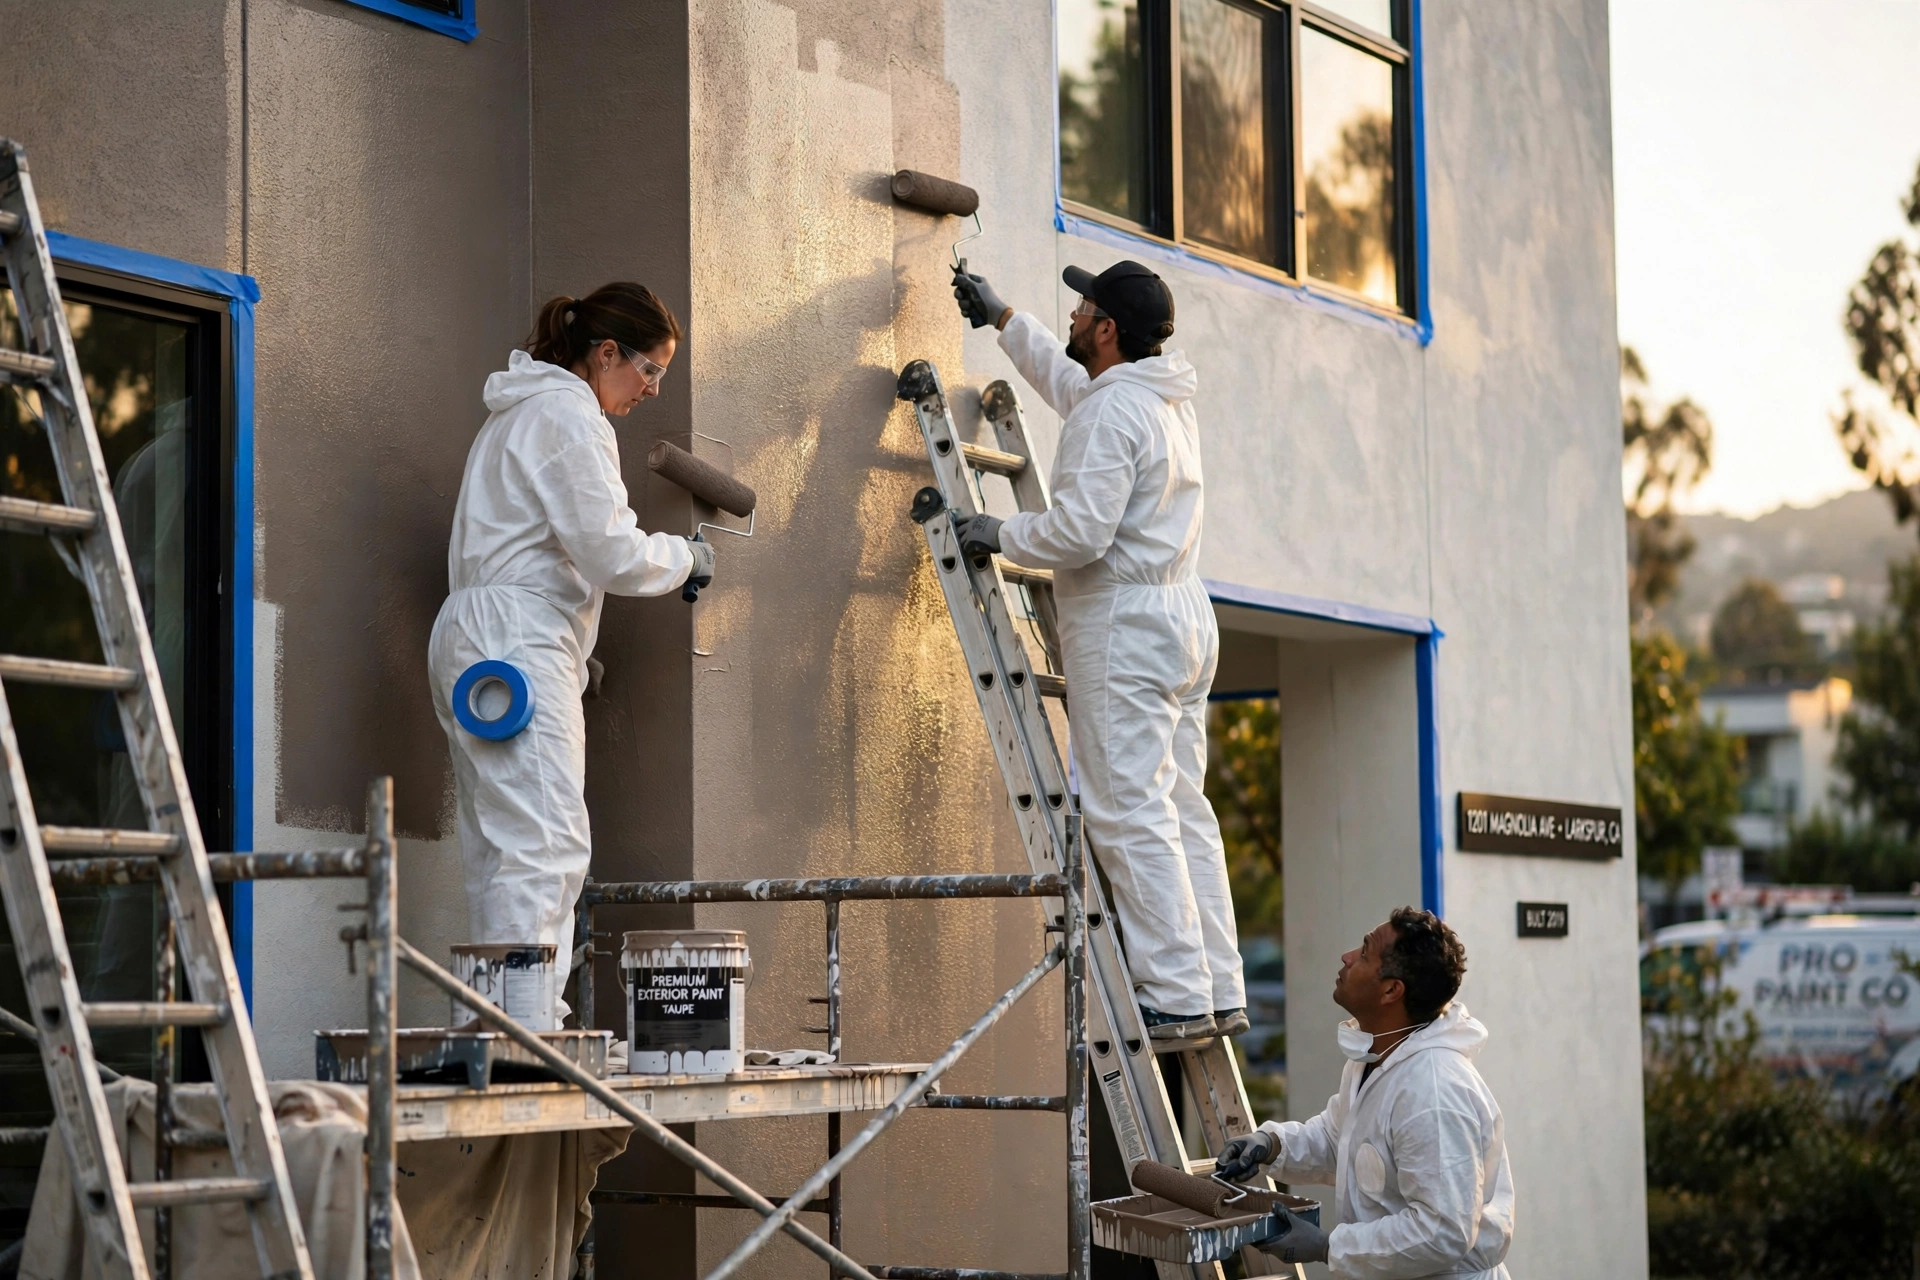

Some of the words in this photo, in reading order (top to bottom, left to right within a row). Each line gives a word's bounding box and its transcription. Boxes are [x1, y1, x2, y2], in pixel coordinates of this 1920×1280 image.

[1467, 809, 1488, 834] 1201
[1489, 811, 1538, 837] MAGNOLIA
[1539, 815, 1556, 840] AVE
[1779, 941, 1857, 974] PRO
[651, 974, 706, 988] PREMIUM
[1860, 975, 1910, 1008] CO
[637, 988, 689, 1001] EXTERIOR
[691, 988, 724, 1001] PAINT
[662, 1003, 695, 1015] TAUPE
